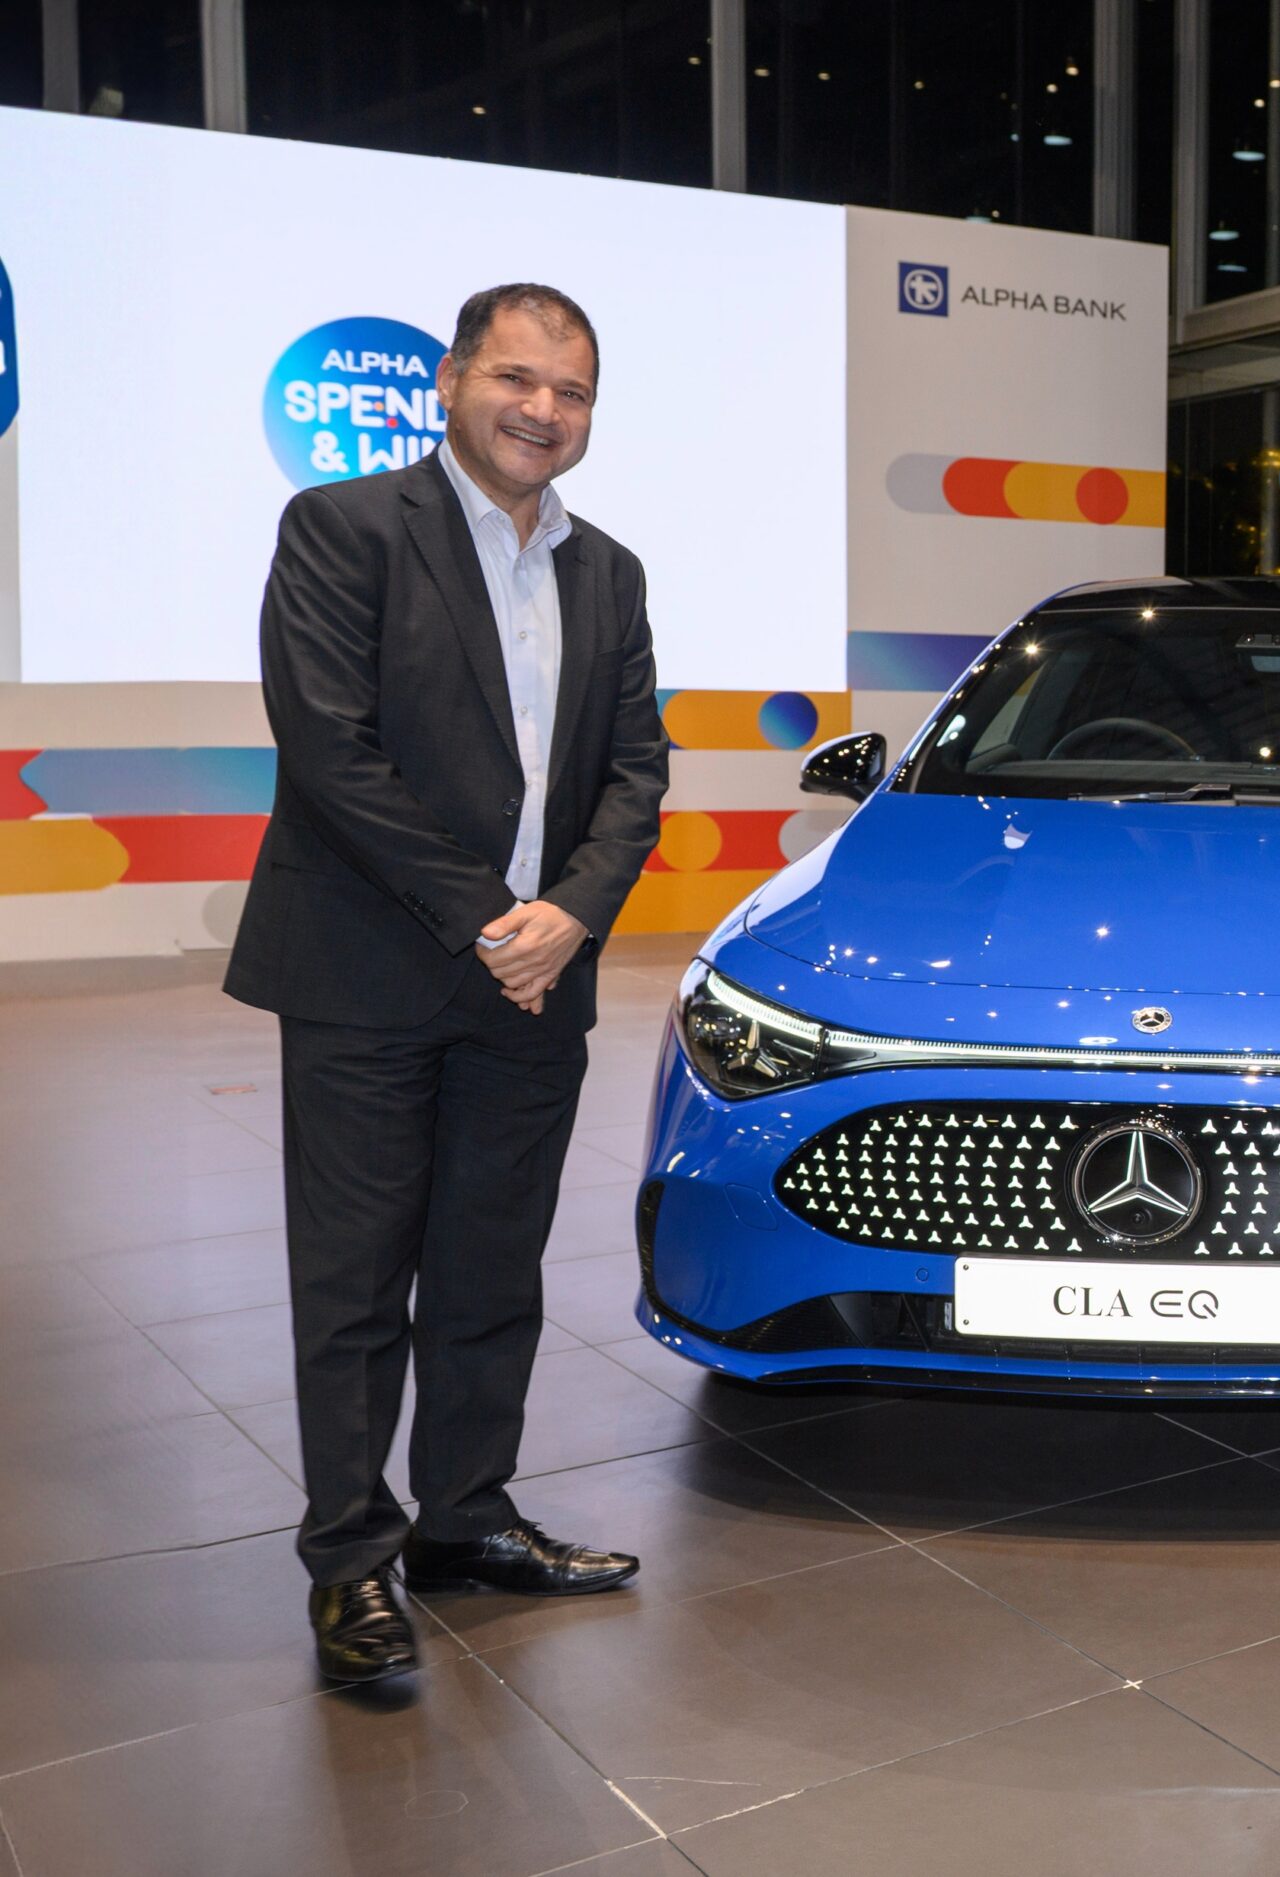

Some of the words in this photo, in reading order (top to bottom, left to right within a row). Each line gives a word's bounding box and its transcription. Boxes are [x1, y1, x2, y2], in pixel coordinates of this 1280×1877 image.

[960, 285, 1048, 312] ALPHA
[1053, 295, 1128, 321] BANK
[321, 349, 430, 378] ALPHA
[310, 430, 349, 473] &
[357, 432, 437, 474] WI
[1053, 1285, 1133, 1317] CLA
[1150, 1290, 1219, 1319] EQ
